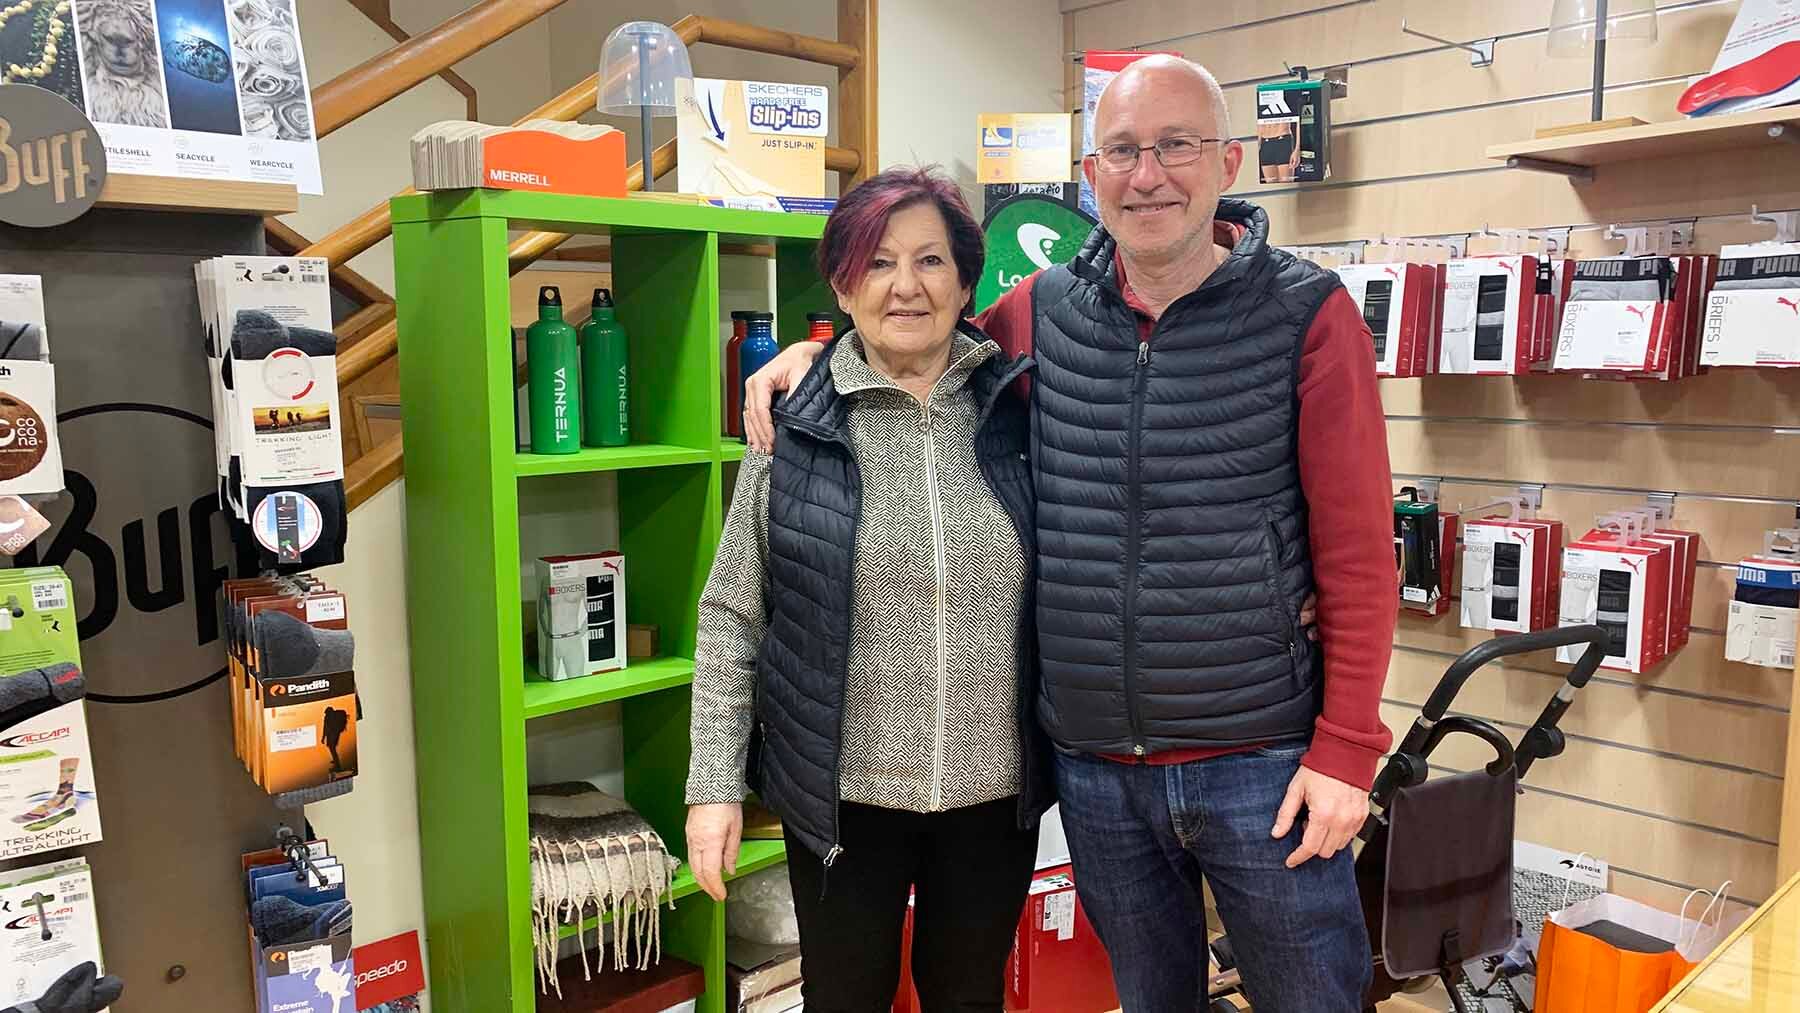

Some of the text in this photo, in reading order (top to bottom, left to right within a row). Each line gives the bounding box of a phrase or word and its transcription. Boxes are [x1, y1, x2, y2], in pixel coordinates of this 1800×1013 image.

[748, 84, 823, 96] SKECHERS
[750, 97, 807, 106] HANDS FREE
[751, 105, 821, 130] Slip-ins
[761, 139, 781, 148] JUST
[175, 152, 215, 163] SEACYCLE
[249, 159, 294, 170] WEARCYCLE
[489, 168, 550, 187] MERRELL
[1574, 261, 1624, 277] PUMA
[1559, 303, 1579, 352] BOXERS
[1706, 296, 1724, 343] BRIEFS
[554, 367, 568, 444] TERNUA
[618, 364, 628, 436] TERNUA
[556, 583, 586, 594] BOXERS
[287, 680, 330, 695] Pandith
[16, 726, 71, 745] ACCAPI
[3, 826, 82, 848] TREKKING
[272, 1000, 309, 1012] Extreme
